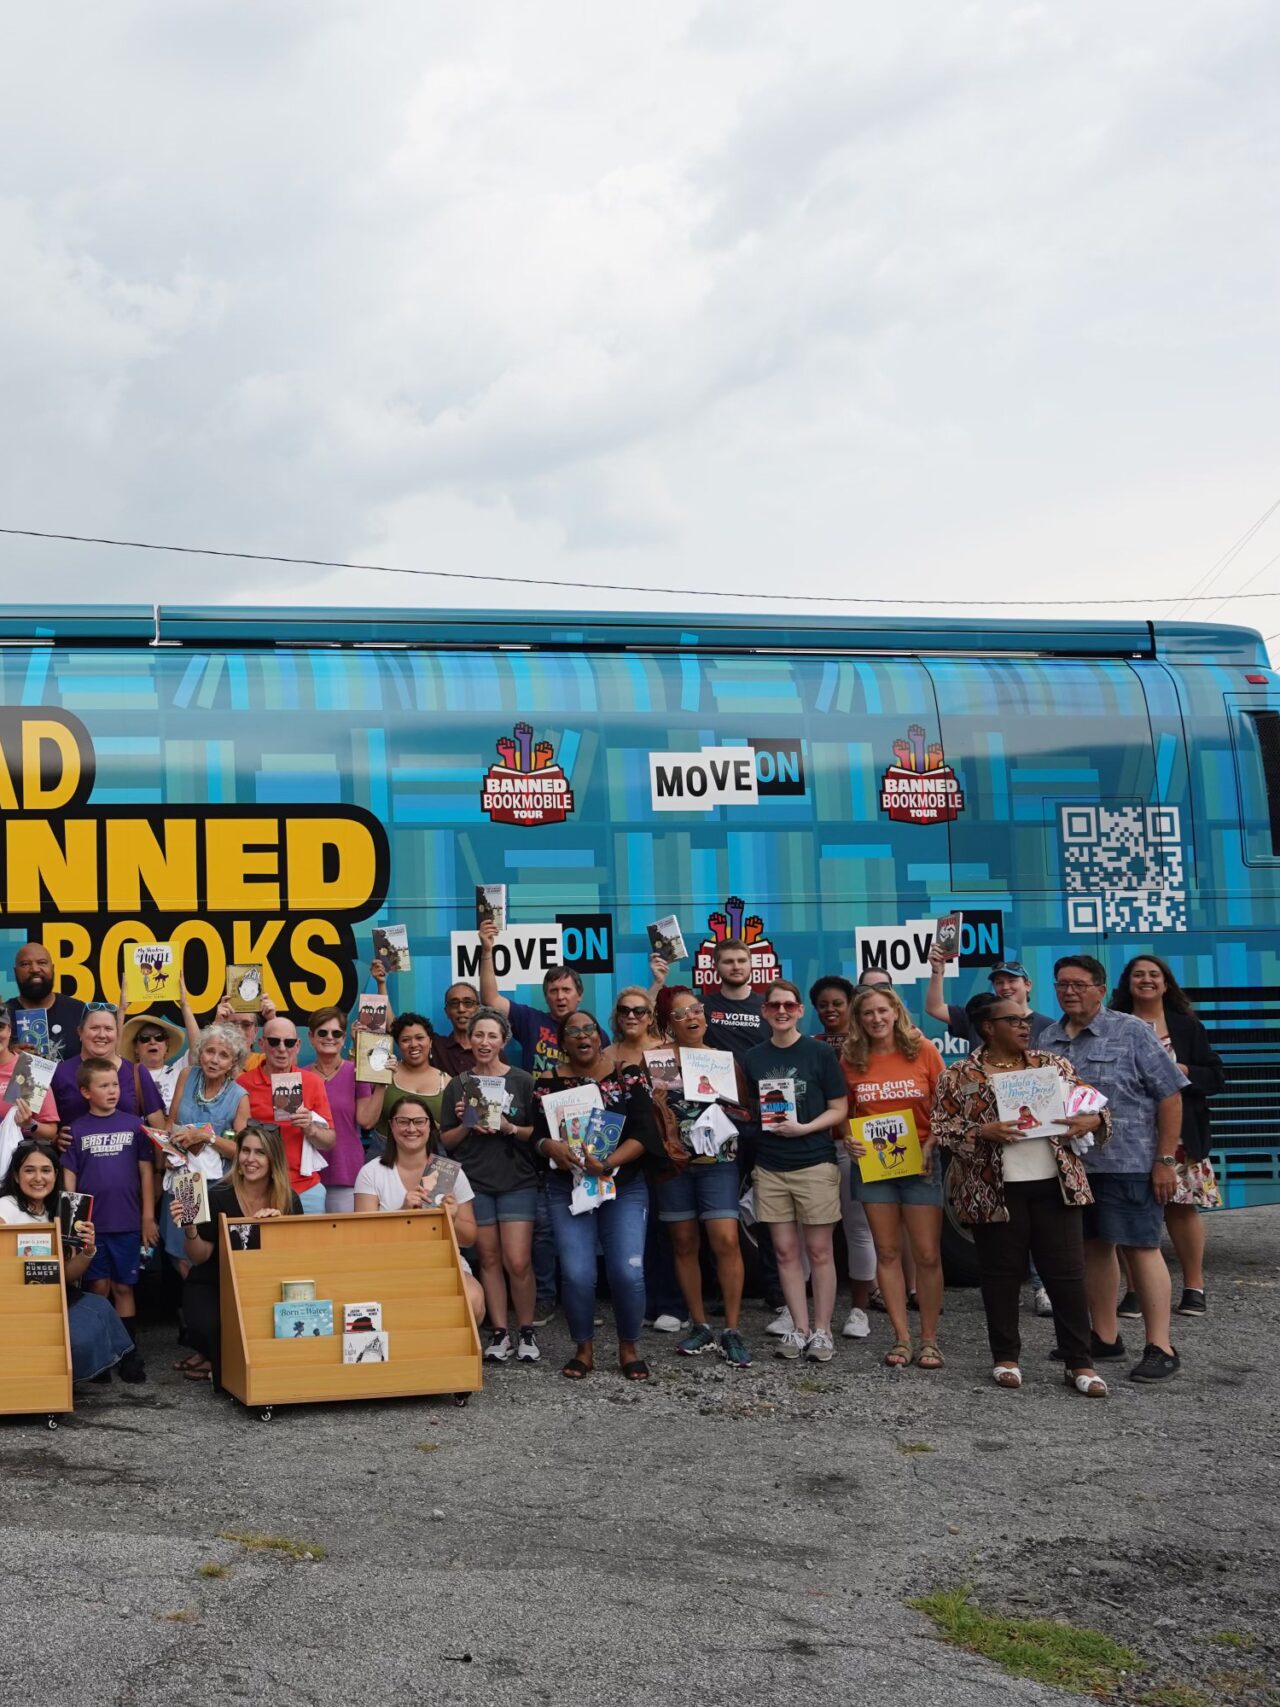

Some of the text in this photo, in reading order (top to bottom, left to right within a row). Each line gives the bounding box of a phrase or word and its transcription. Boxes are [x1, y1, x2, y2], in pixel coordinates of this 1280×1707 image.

[656, 751, 800, 797] MOVE ON
[486, 779, 567, 792] BANNED
[884, 779, 958, 792] BANNED
[483, 794, 571, 809] BOOKMOBILE
[882, 794, 962, 808] BOOKMOBLE
[513, 810, 543, 819] TOUR
[910, 809, 938, 817] TOUR
[457, 927, 608, 977] MOVE ON
[861, 923, 999, 971] MOV ON
[42, 919, 344, 1014] BOOKS
[698, 953, 776, 969] BED
[695, 969, 780, 985] BOOBILE
[720, 1019, 760, 1028] TOMORROW
[725, 1012, 761, 1022] VOTERS
[856, 1079, 916, 1093] Ban guns
[857, 1088, 924, 1102] not books.
[280, 1309, 300, 1317] Born
[305, 1307, 327, 1315] Water
